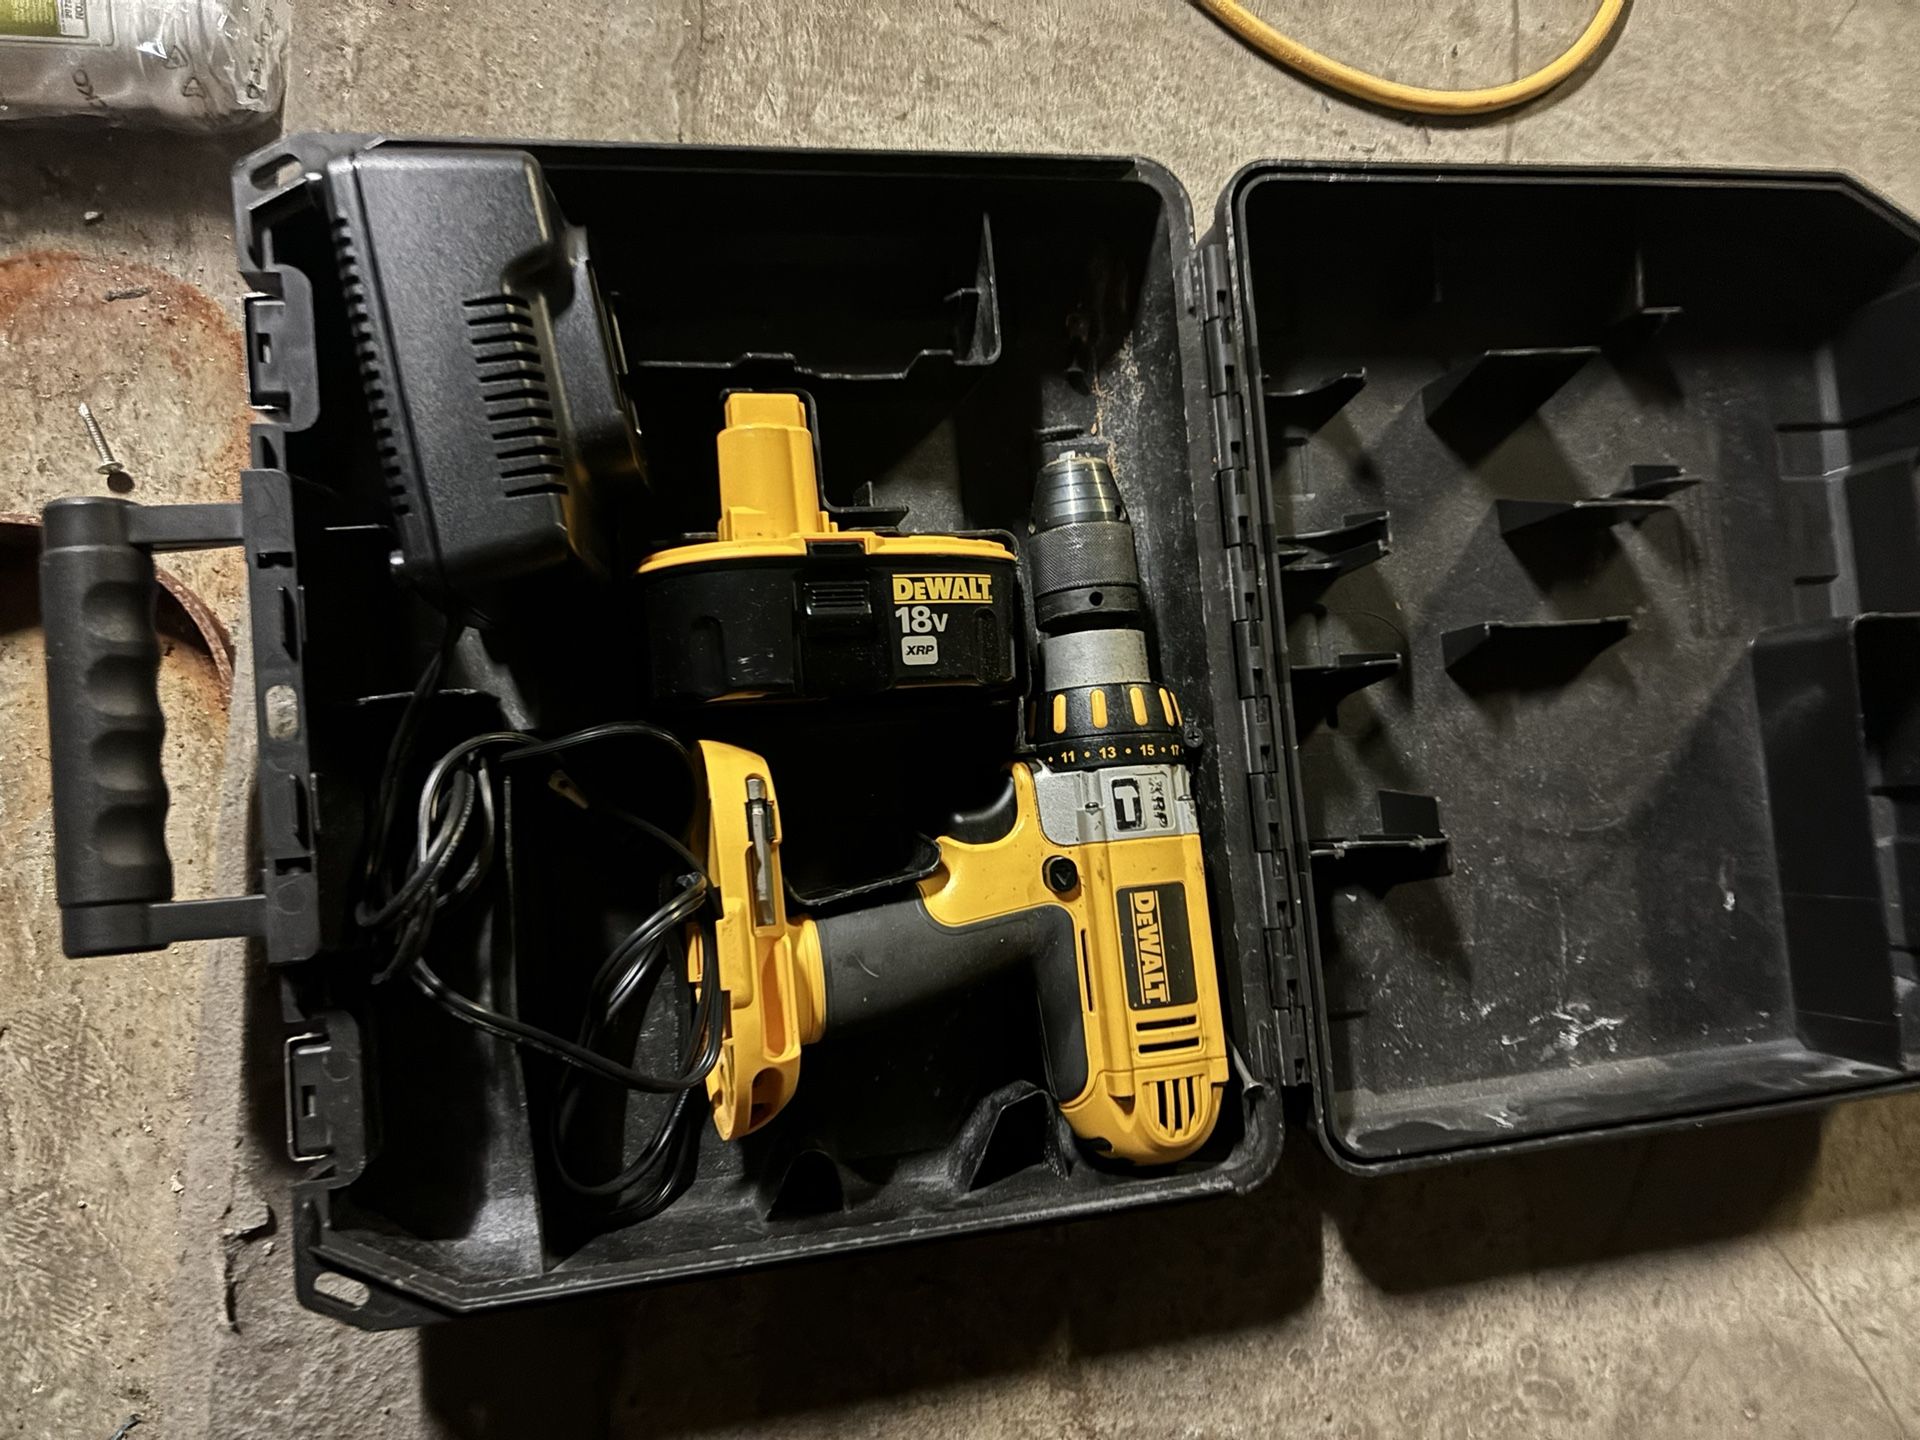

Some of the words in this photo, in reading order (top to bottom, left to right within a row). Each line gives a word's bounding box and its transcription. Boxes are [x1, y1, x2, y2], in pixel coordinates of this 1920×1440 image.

[906, 645, 934, 656] XRP
[1061, 750, 1075, 763] 11
[1099, 746, 1117, 759] 13
[1140, 744, 1155, 756] 15
[1170, 744, 1180, 756] 17
